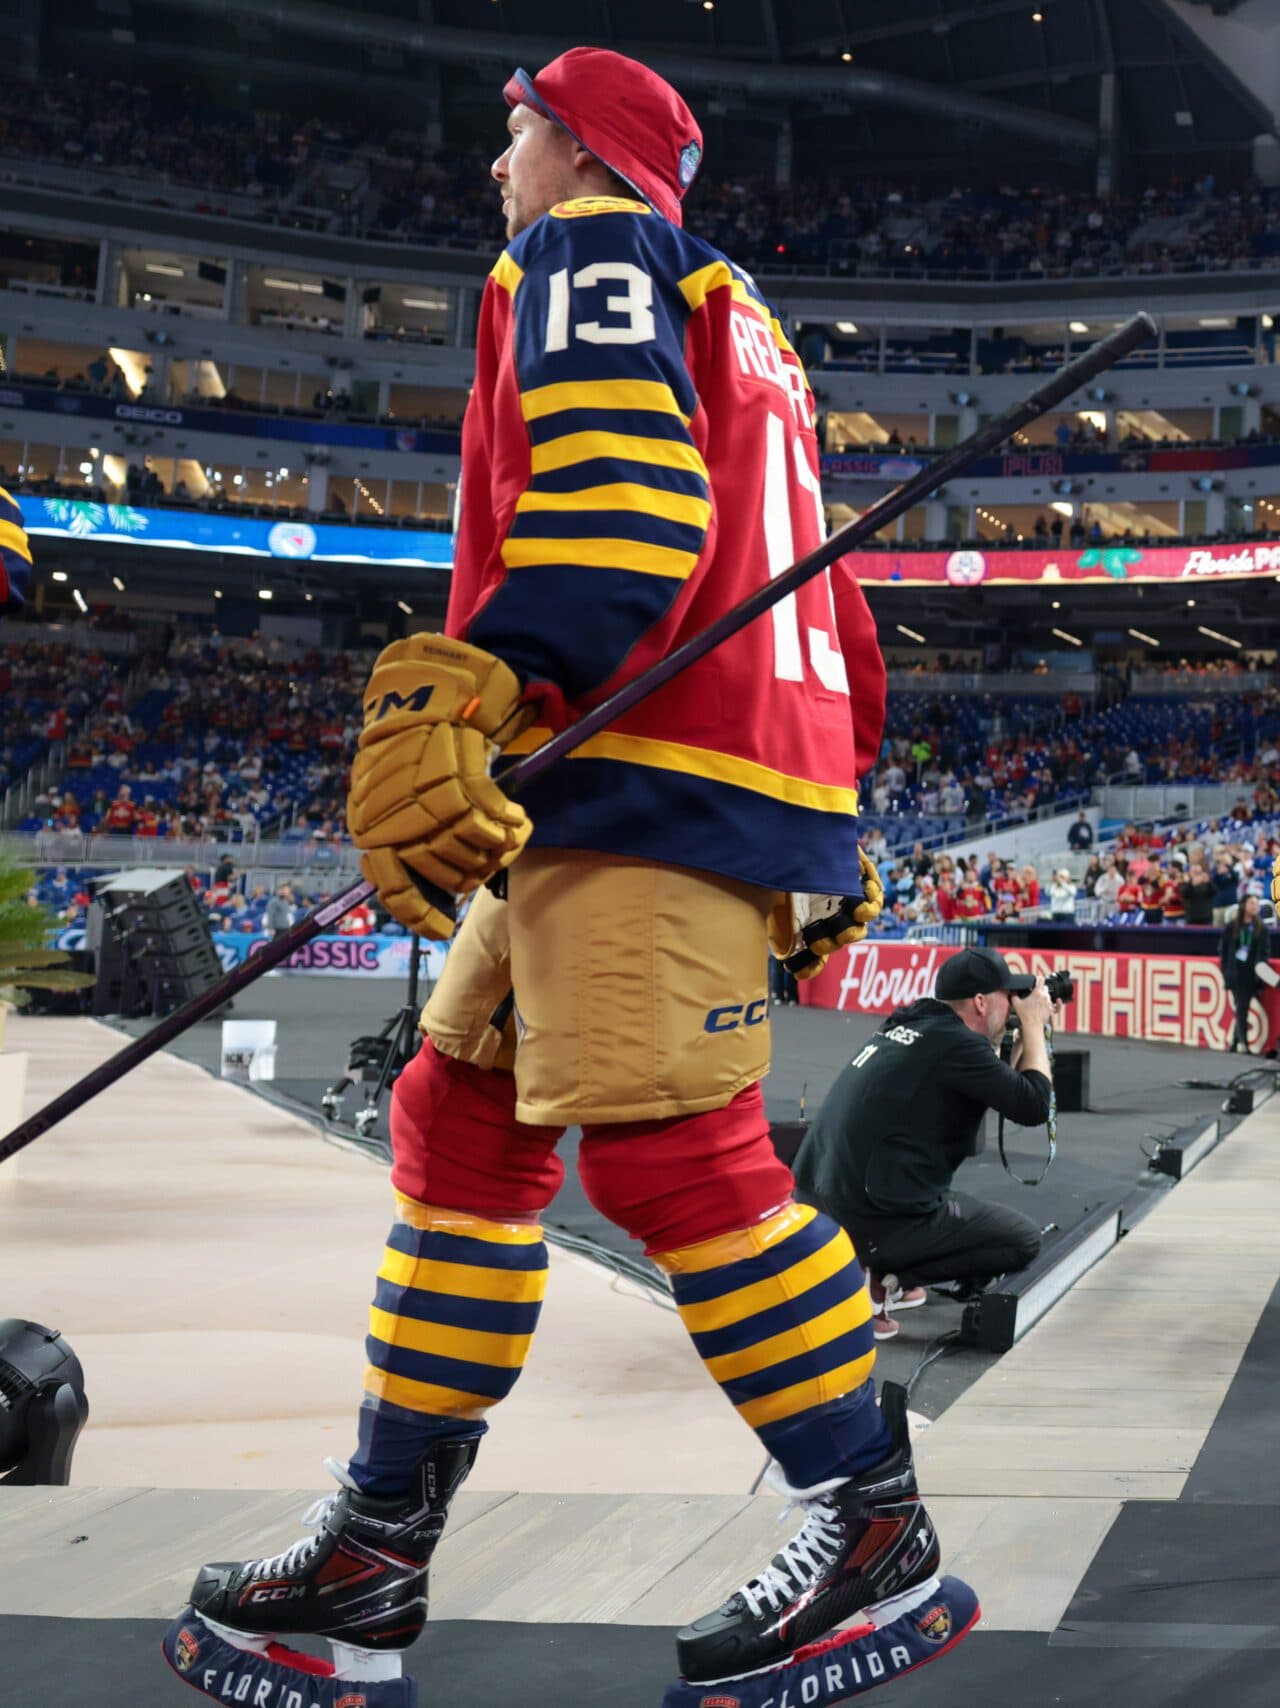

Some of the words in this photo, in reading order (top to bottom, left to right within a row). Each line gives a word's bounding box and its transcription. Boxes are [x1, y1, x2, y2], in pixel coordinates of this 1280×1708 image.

[544, 261, 656, 353] 13
[115, 405, 183, 424] GEICO
[1182, 550, 1254, 577] Florida
[704, 998, 767, 1034] CC
[426, 1462, 440, 1499] CCM
[252, 1586, 307, 1603] CCM
[203, 1668, 321, 1708] FLORID
